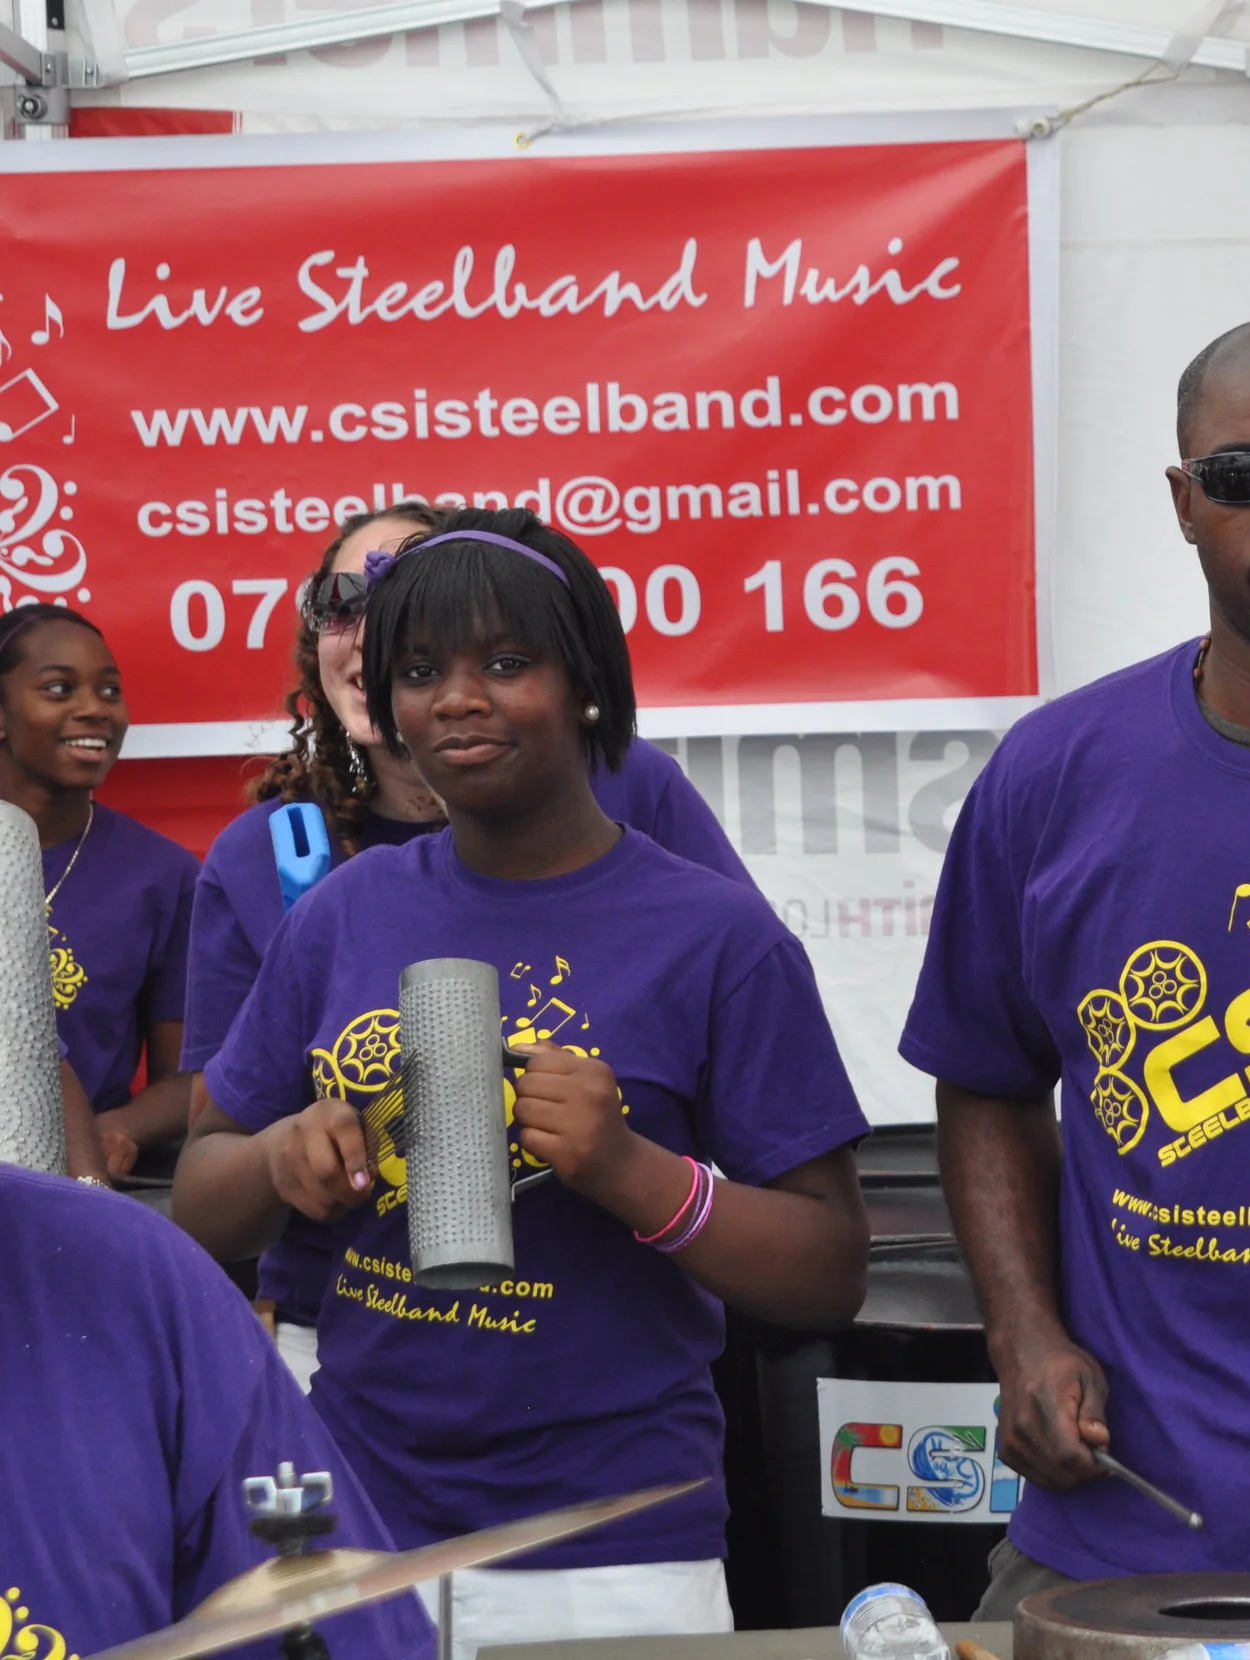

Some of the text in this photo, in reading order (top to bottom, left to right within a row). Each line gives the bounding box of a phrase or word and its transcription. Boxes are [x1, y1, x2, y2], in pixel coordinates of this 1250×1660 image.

[105, 236, 962, 333] Live Steelband Music
[131, 376, 961, 449] www.csisteelband.com
[742, 555, 925, 634] 166
[365, 1284, 460, 1324] Steelband
[467, 1304, 537, 1333] Music
